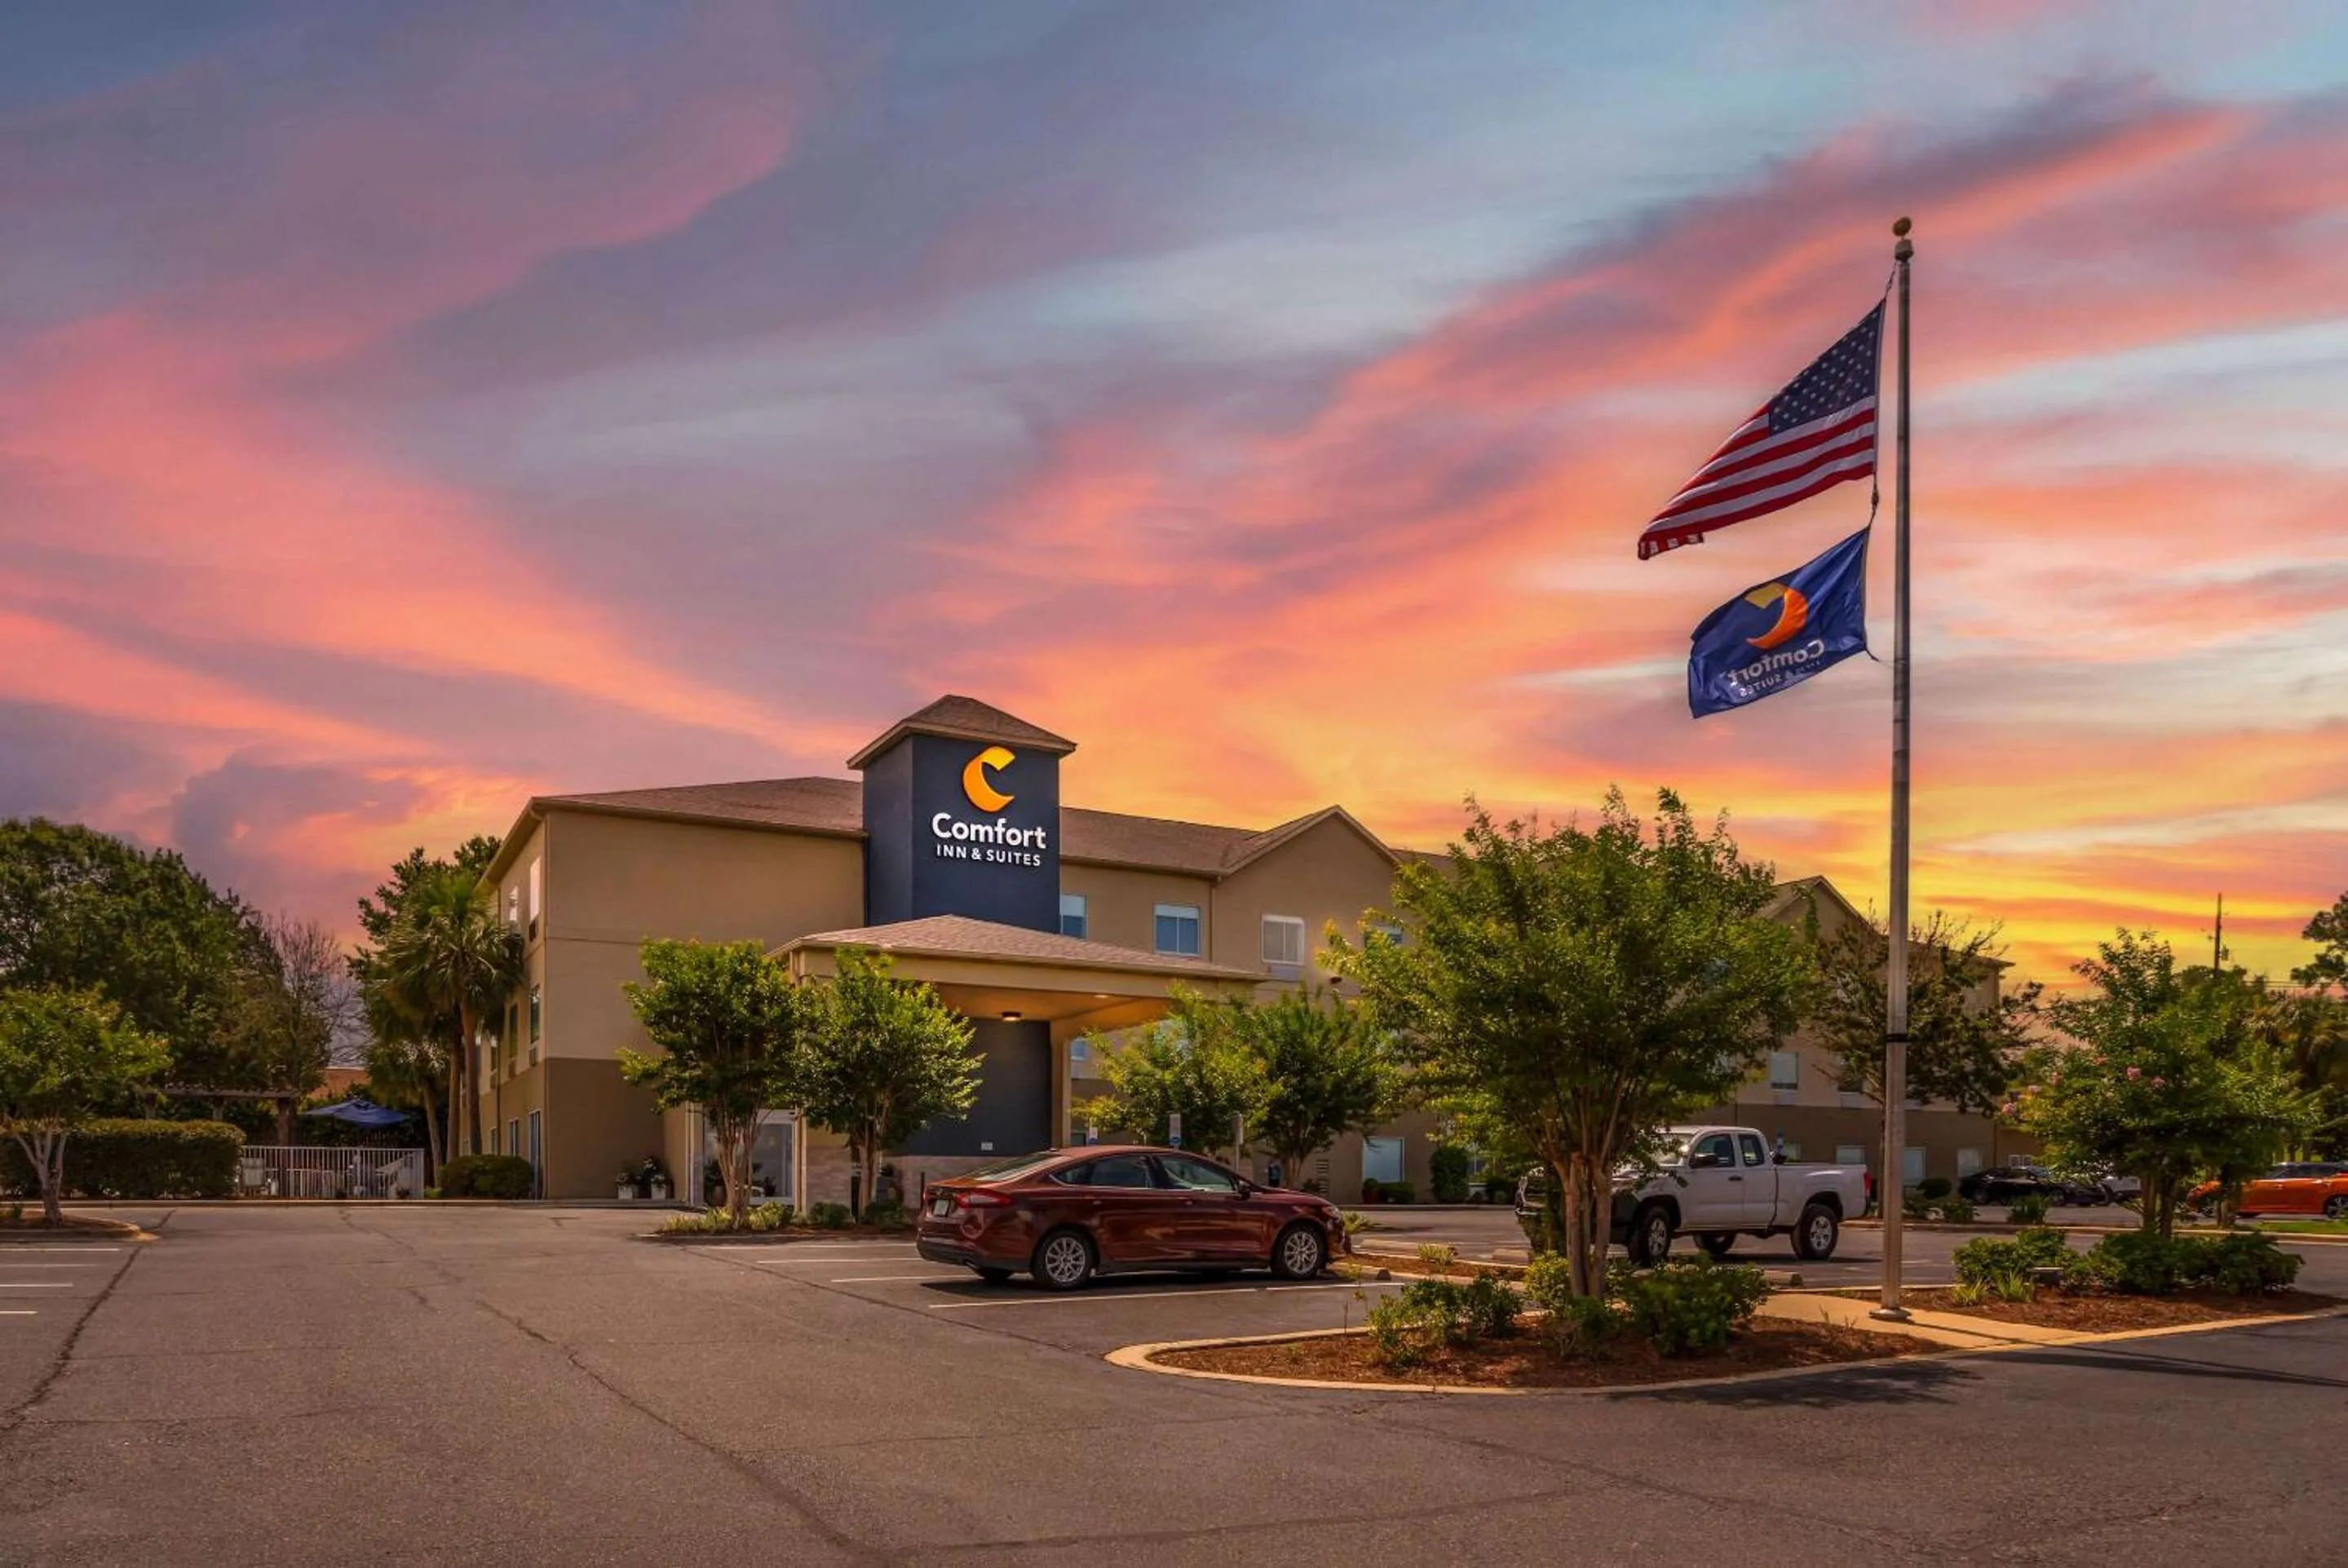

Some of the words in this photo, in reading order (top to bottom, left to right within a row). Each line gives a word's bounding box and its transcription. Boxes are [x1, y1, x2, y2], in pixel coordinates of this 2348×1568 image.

[932, 812, 1046, 849] Comfort
[936, 844, 967, 858] INN
[971, 848, 982, 859] &
[986, 849, 1041, 867] SUITES
